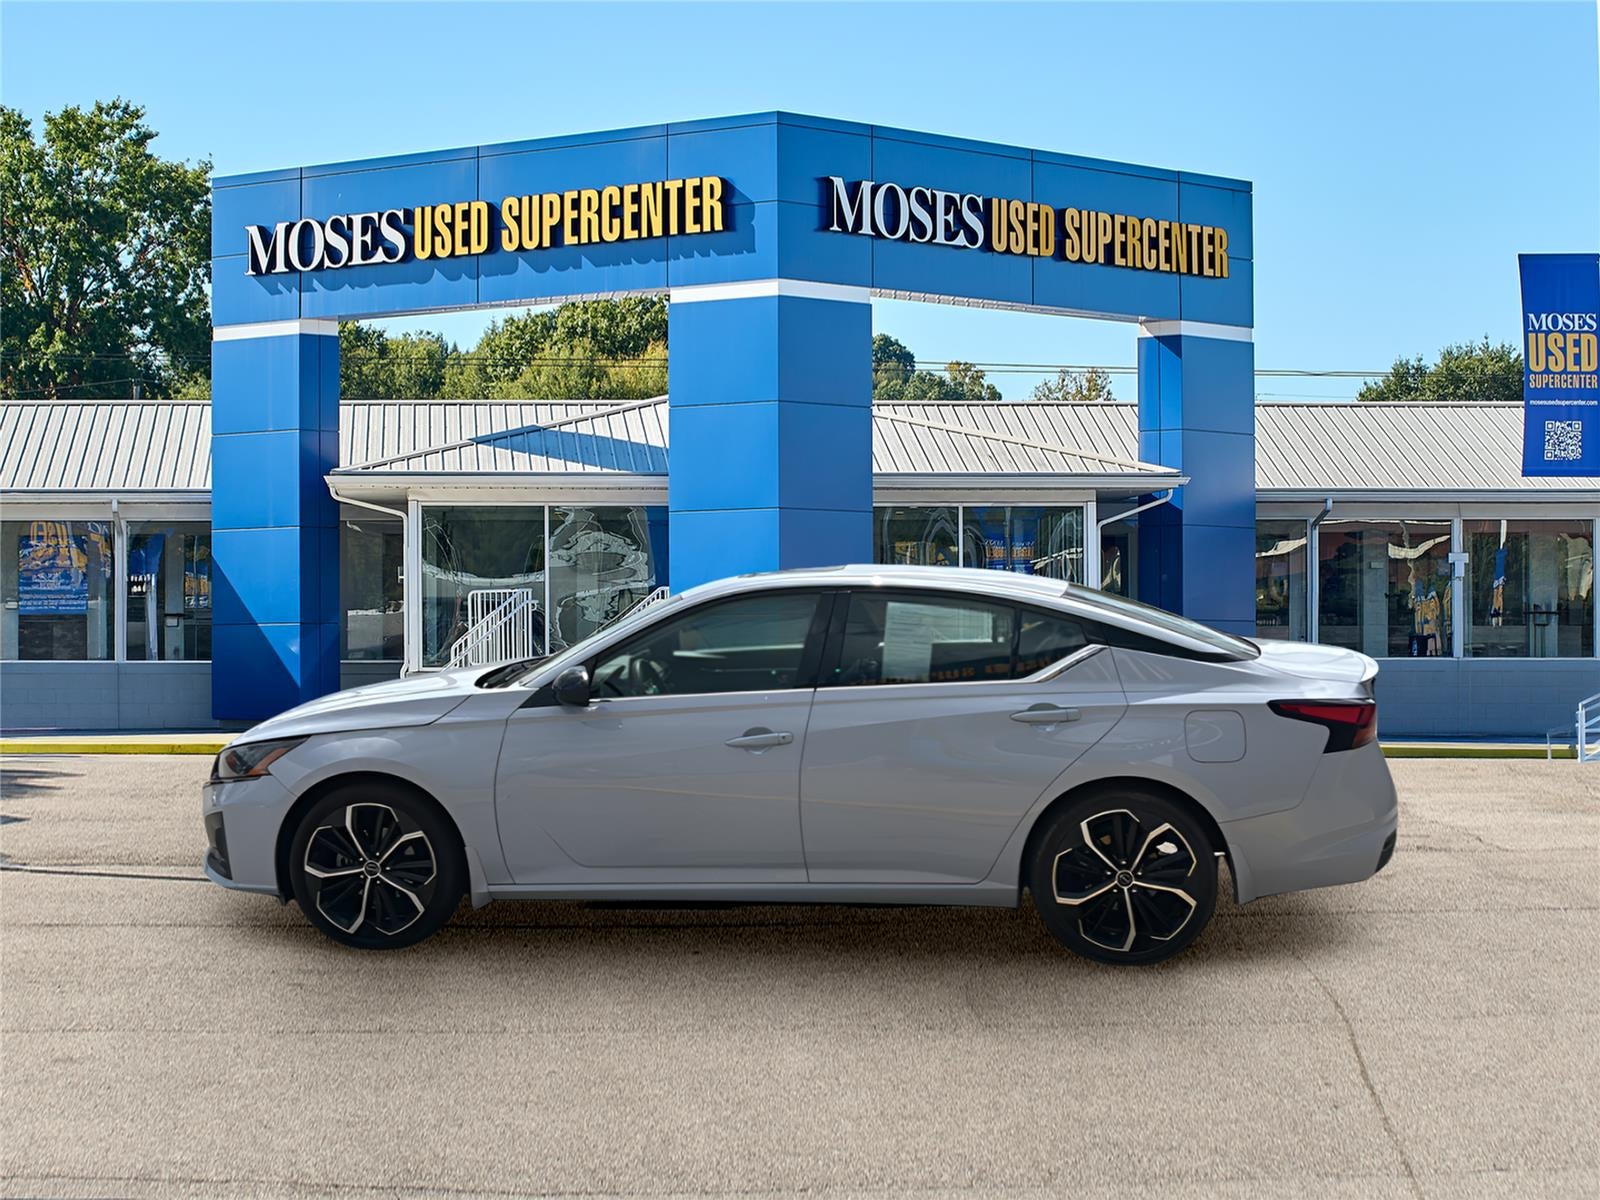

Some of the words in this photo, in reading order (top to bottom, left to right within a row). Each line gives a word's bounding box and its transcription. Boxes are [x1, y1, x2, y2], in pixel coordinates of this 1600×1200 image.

[244, 209, 409, 276] MOSES
[414, 200, 489, 260] USED
[500, 175, 724, 252] SUPERCENTER
[828, 175, 985, 249] MOSES
[991, 197, 1055, 257] USED
[1064, 207, 1229, 278] SUPERCENTER
[1527, 313, 1597, 331] MOSES
[1528, 333, 1598, 372] USED
[1529, 374, 1598, 389] SUPERCENTER
[1529, 398, 1598, 406] mosesusedsupercenter.com
